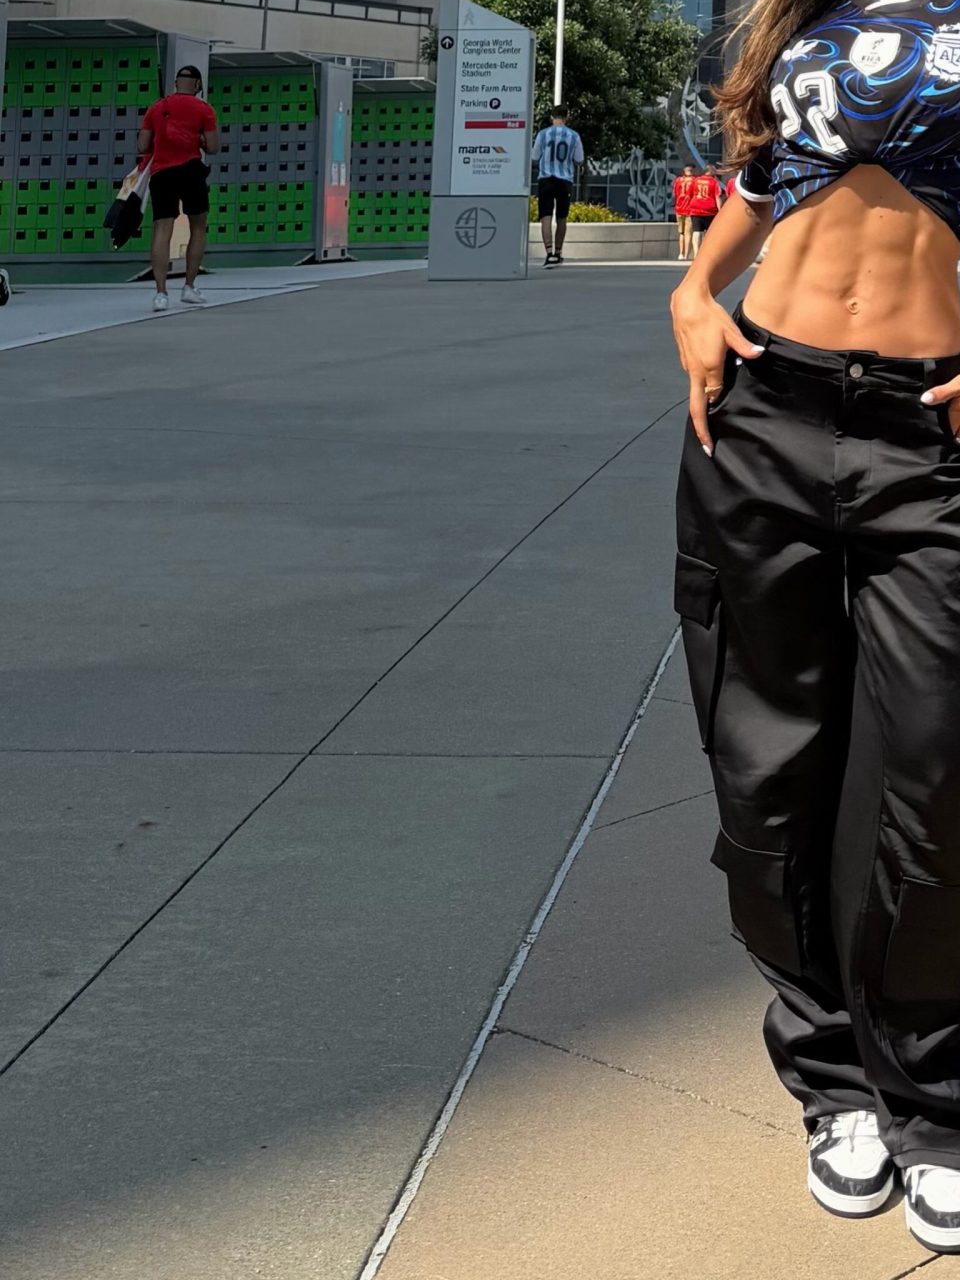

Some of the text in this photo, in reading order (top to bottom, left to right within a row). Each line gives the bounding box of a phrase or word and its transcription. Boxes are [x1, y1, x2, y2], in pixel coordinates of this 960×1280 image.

[463, 39, 513, 47] Georgia World
[463, 47, 496, 55] Congress
[462, 61, 518, 69] Mercedes-Benz
[461, 85, 480, 93] State
[460, 100, 488, 108] Parking
[458, 146, 491, 154] marta
[547, 140, 568, 162] 10
